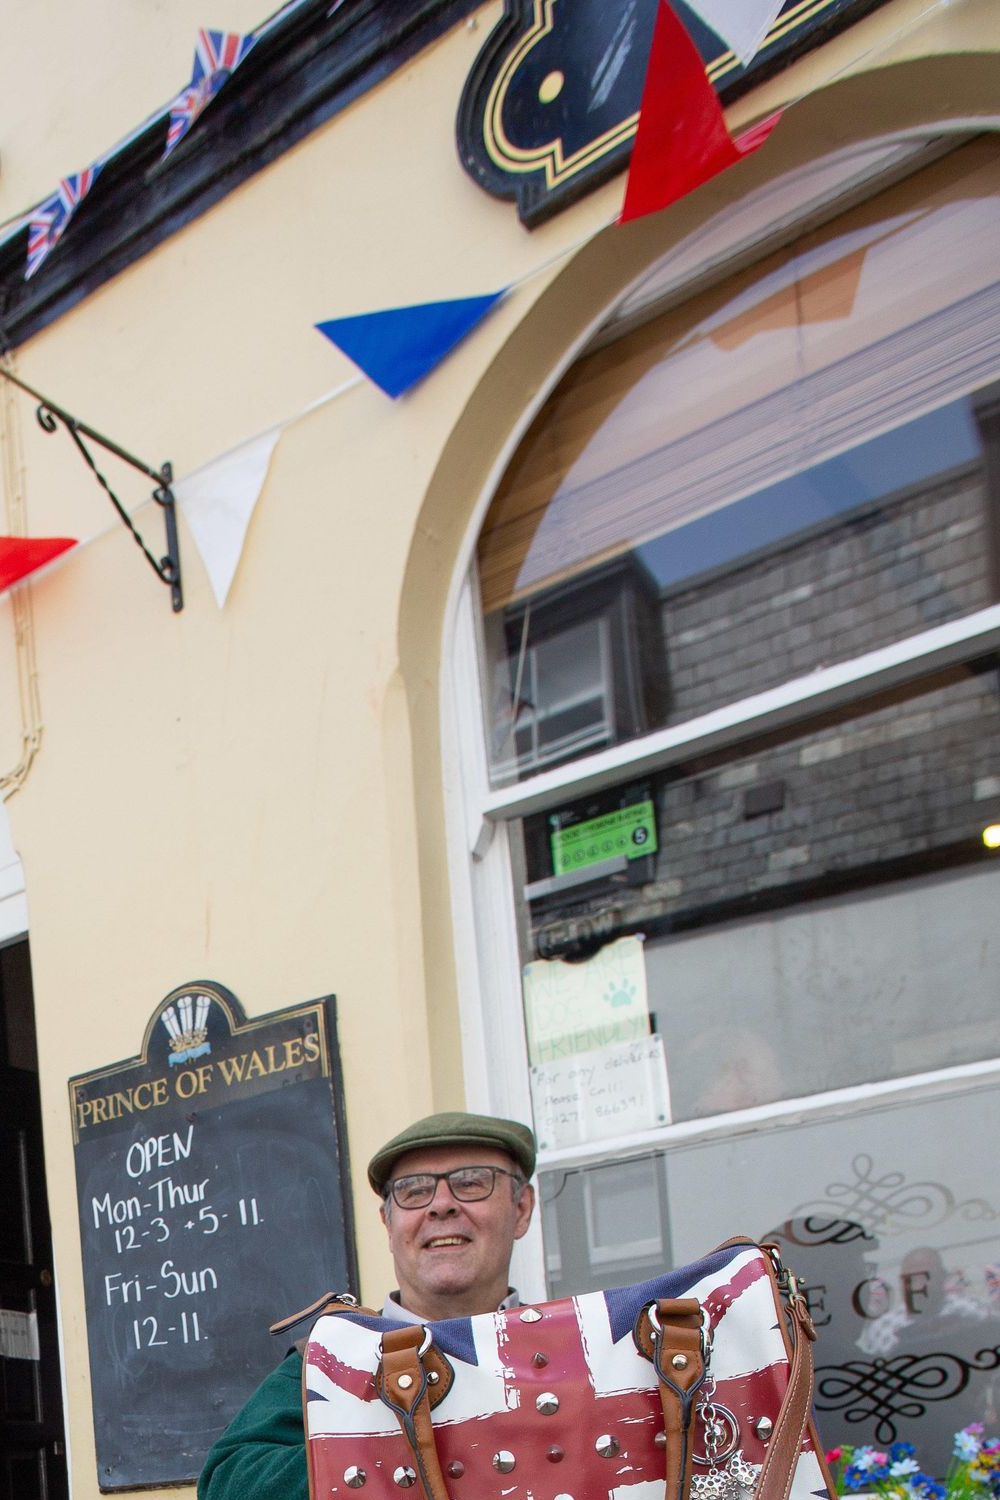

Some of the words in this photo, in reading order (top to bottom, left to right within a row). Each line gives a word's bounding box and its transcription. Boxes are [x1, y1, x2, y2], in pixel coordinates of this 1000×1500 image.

[76, 1077, 170, 1129] PRINCE
[175, 1064, 213, 1100] OF
[217, 1032, 321, 1087] WALES
[125, 1124, 194, 1179] OPEN
[91, 1176, 210, 1230] Mon-Thur
[114, 1216, 170, 1254] 12-3
[104, 1260, 218, 1306] Fri-Sun
[851, 1270, 931, 1321] OF
